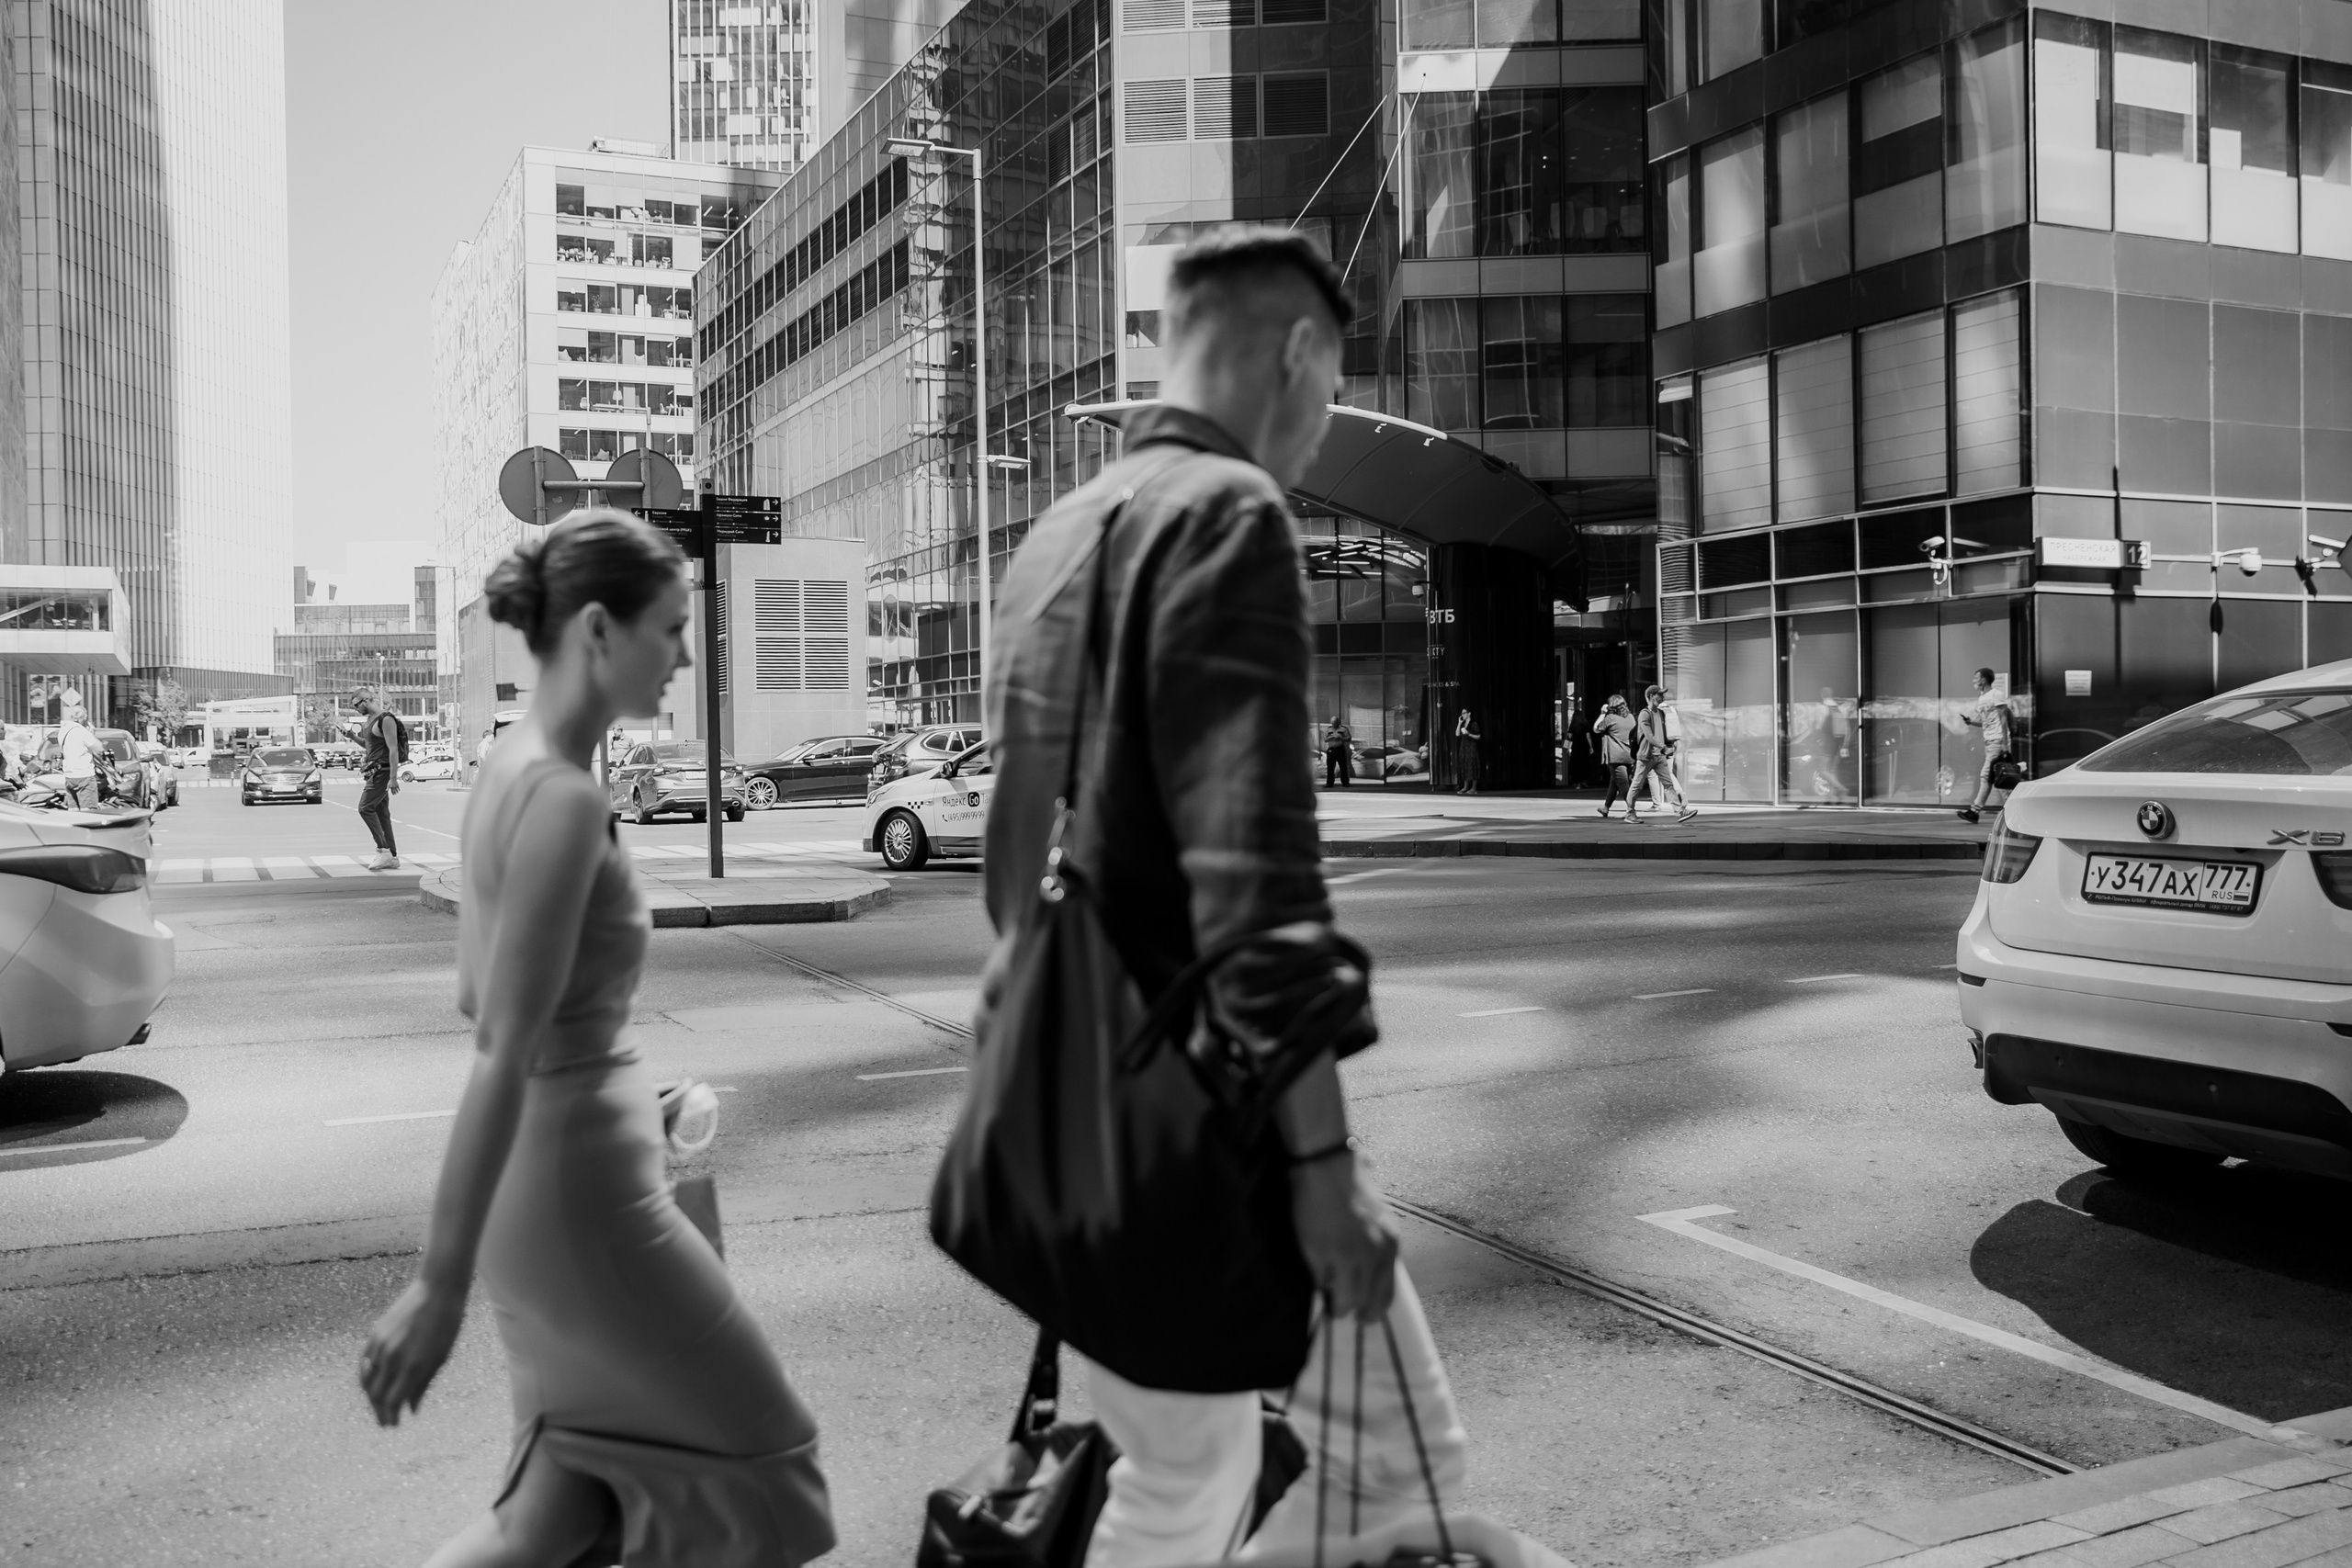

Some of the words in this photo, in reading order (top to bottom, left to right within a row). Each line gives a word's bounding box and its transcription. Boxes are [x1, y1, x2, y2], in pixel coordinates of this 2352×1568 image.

[2050, 541, 2117, 553] ПРЕСНЕНСКАЯ
[2128, 545, 2147, 564] 12
[1430, 608, 1455, 625] ВТБ
[942, 795, 967, 807] Яндекс
[968, 793, 979, 806] Go
[2140, 805, 2163, 817] BMW
[2266, 829, 2346, 847] X6
[2095, 894, 2131, 903] РОЛЬФ-Премиум
[2211, 890, 2233, 900] RUS
